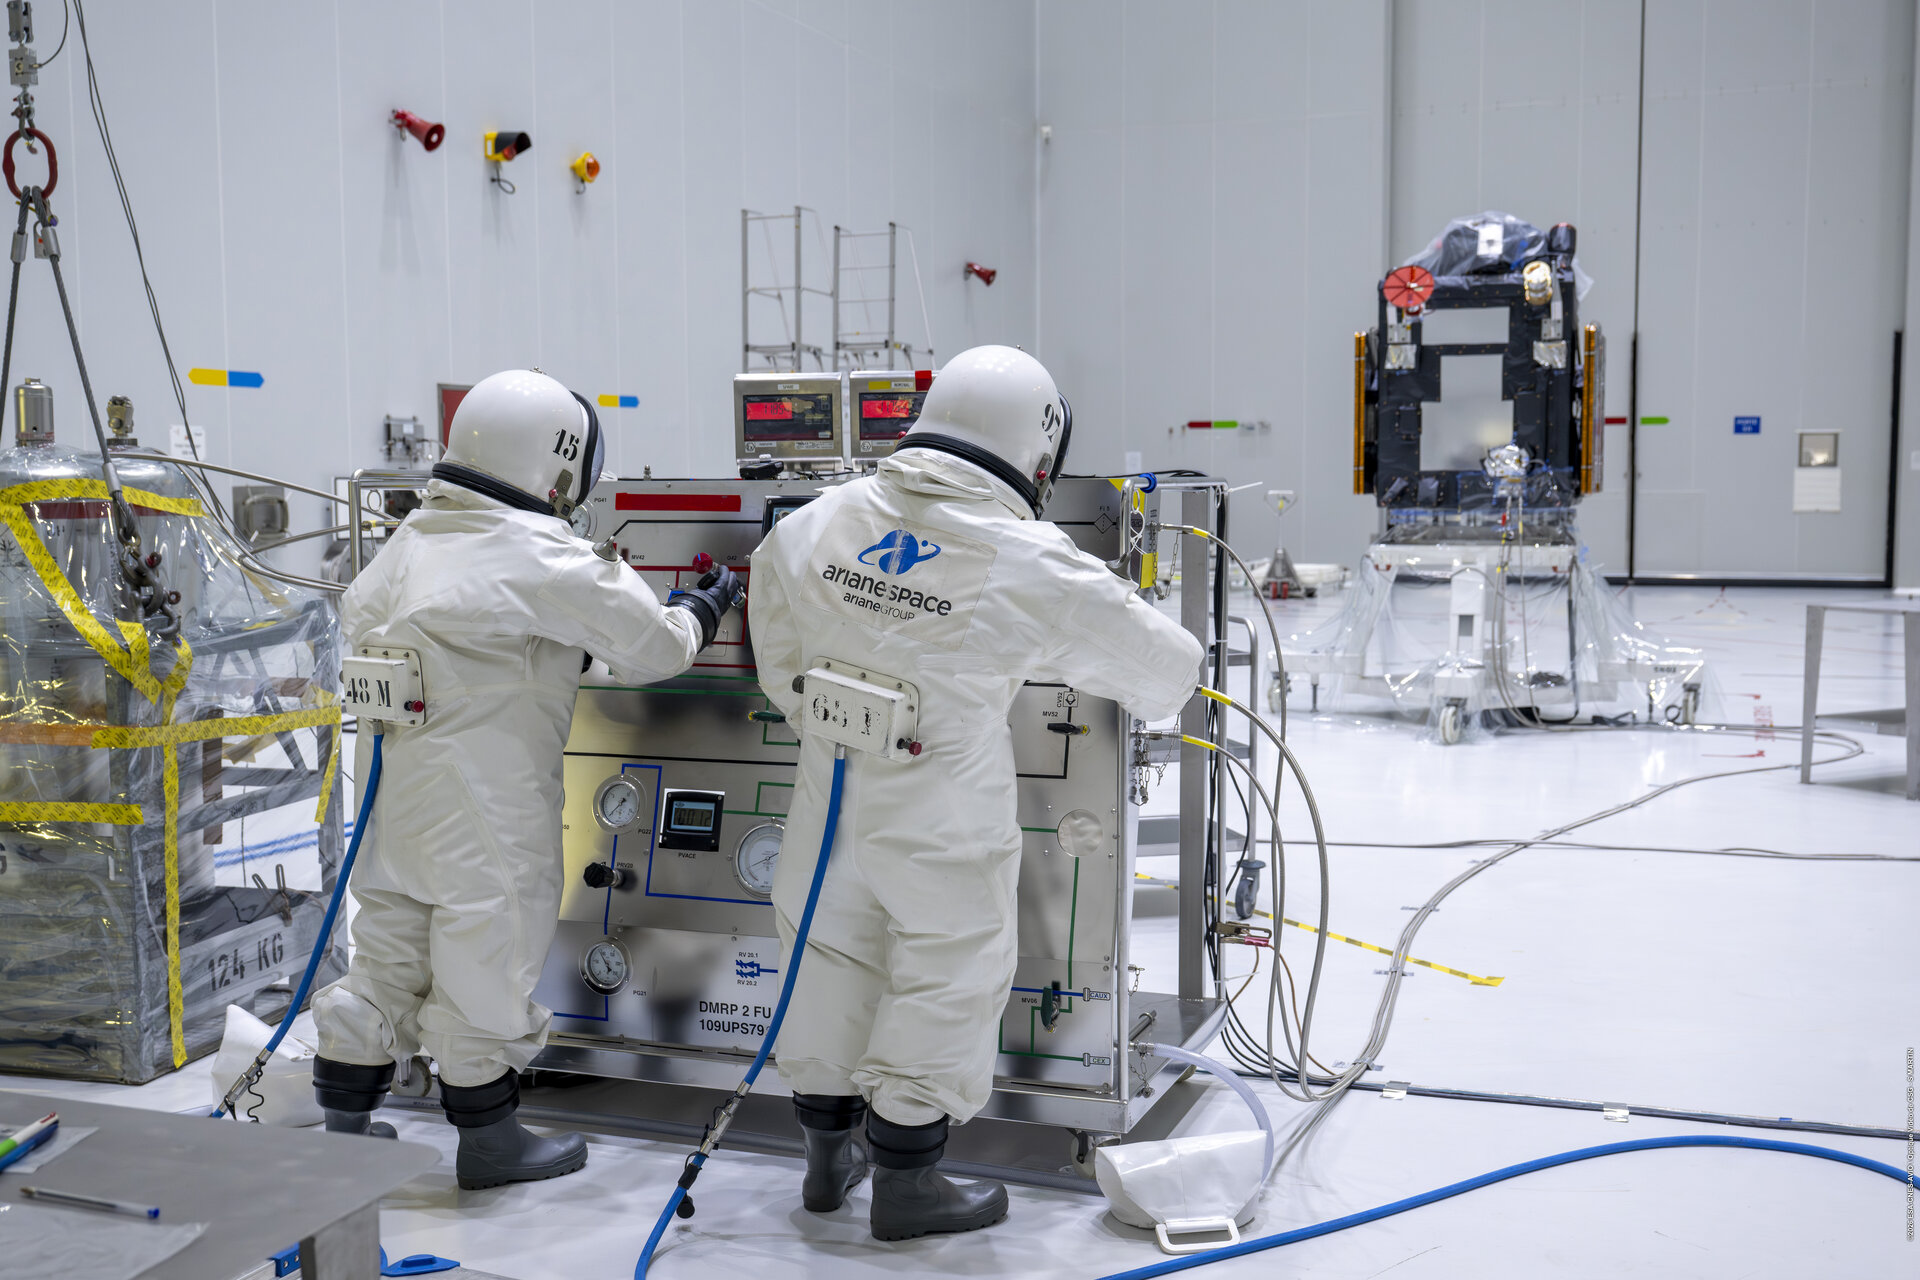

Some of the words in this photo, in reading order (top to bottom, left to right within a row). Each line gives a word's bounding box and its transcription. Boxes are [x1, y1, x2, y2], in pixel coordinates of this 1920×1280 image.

[552, 428, 580, 461] 15
[346, 677, 371, 704] 48
[376, 679, 392, 708] M
[208, 948, 245, 991] 124
[257, 932, 283, 971] KG
[699, 1000, 738, 1015] DMRP
[742, 1005, 750, 1017] 2
[754, 1006, 772, 1019] FU
[699, 1019, 770, 1037] 109UPS79
